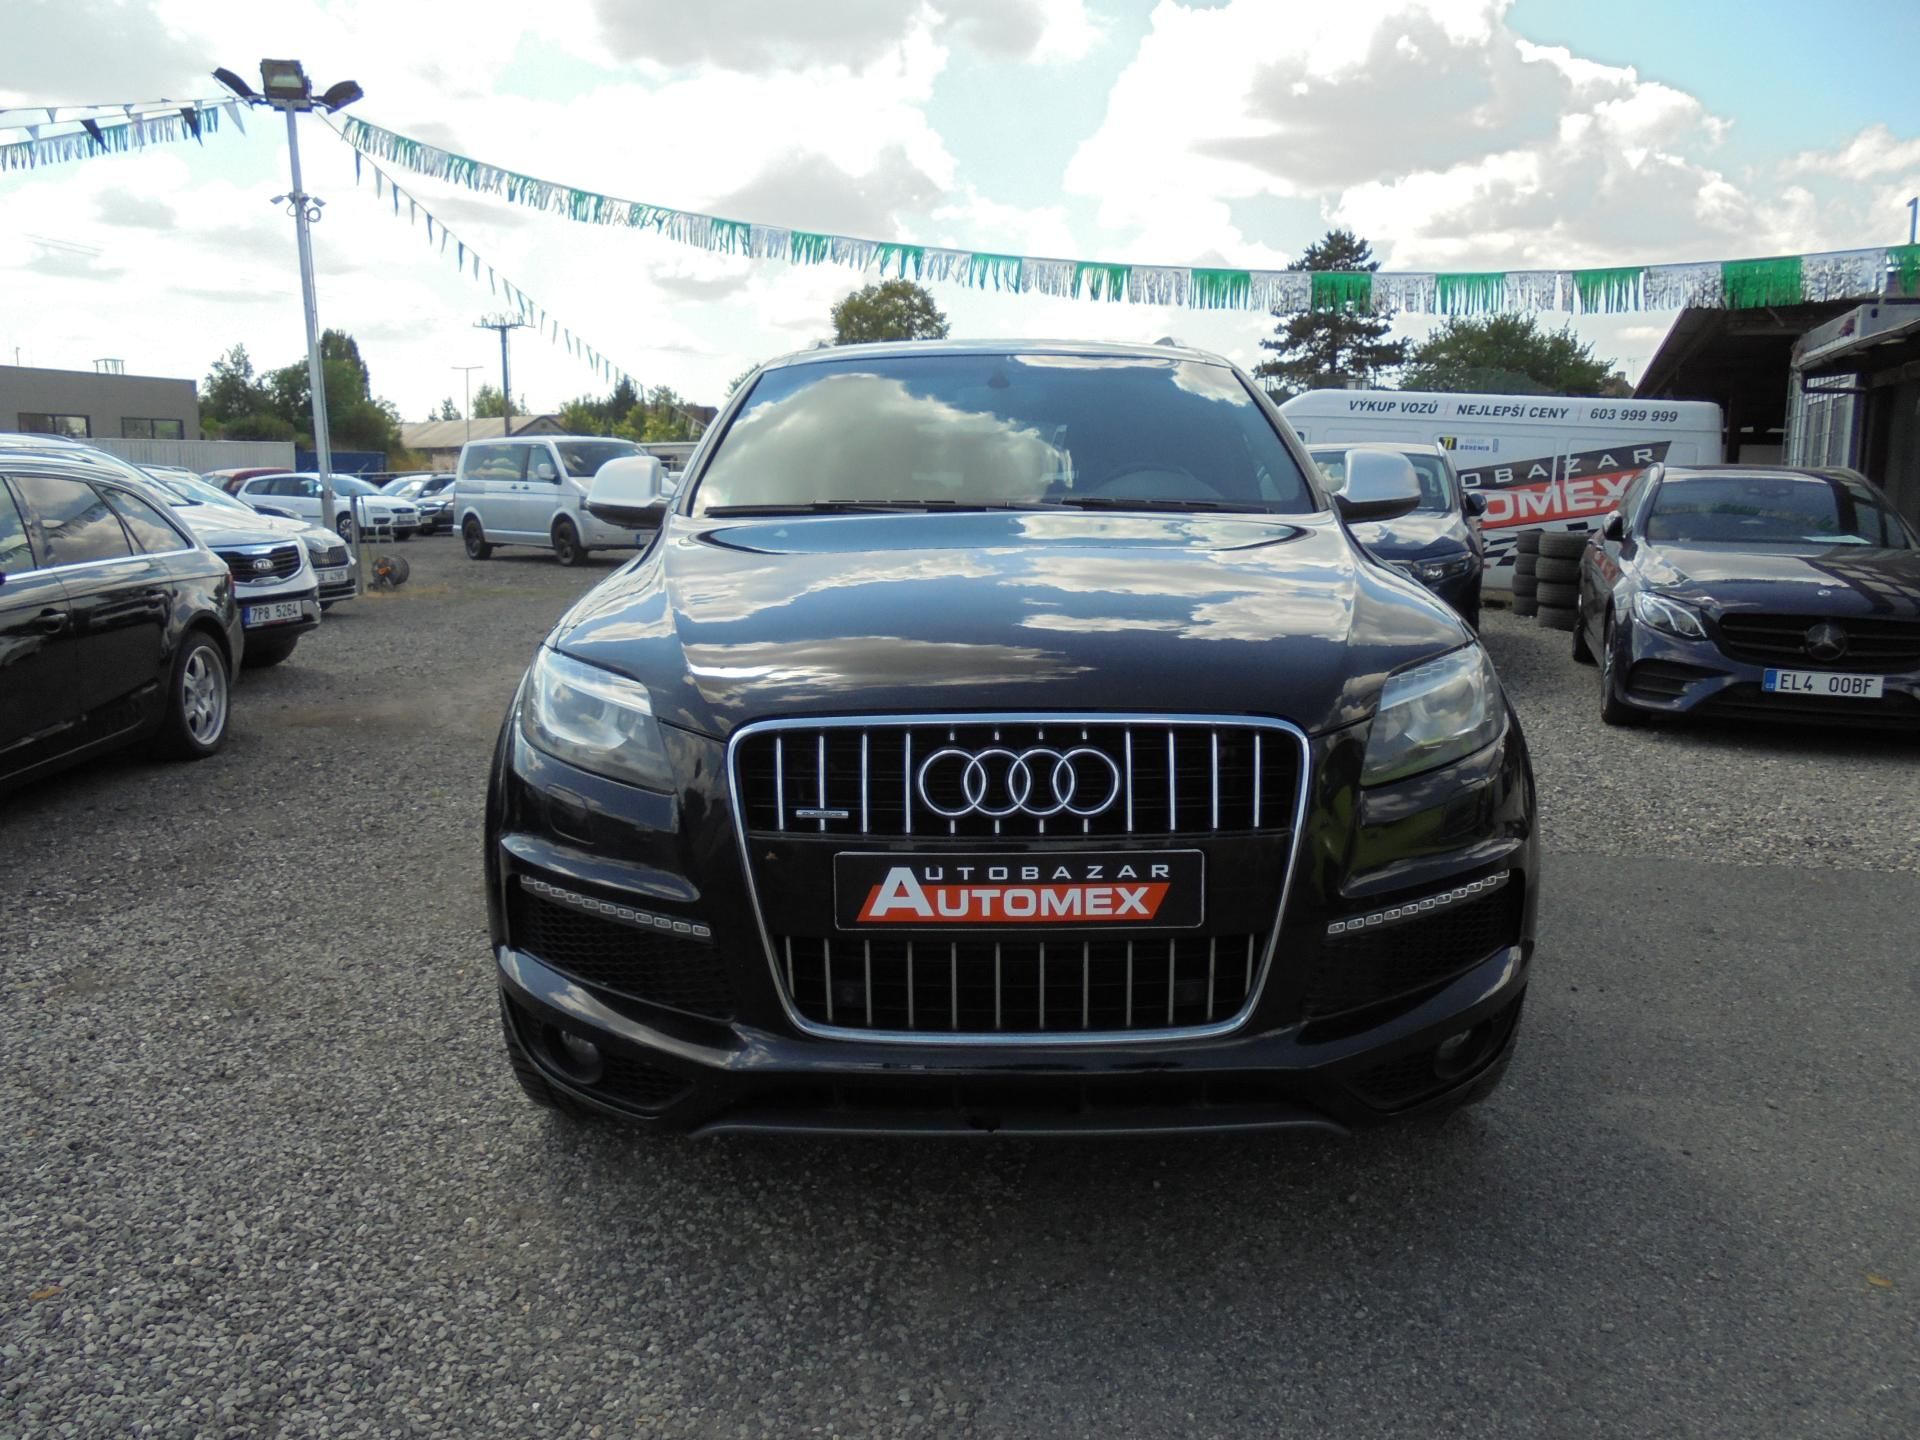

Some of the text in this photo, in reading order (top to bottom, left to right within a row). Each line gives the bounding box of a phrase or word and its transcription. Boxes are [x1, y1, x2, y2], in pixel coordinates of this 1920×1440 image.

[1349, 398, 1396, 412] VÝKUP
[1456, 404, 1526, 417] NEJLEPŠÍ
[1529, 407, 1568, 419] CENY
[1590, 408, 1616, 420] 603
[1620, 409, 1647, 421] 999
[1651, 411, 1678, 423] 999
[1460, 448, 1654, 488] OBAZAR
[1483, 474, 1633, 522] OMEX
[1780, 673, 1813, 692] EL4
[869, 866, 1151, 917] AUTOMEX
